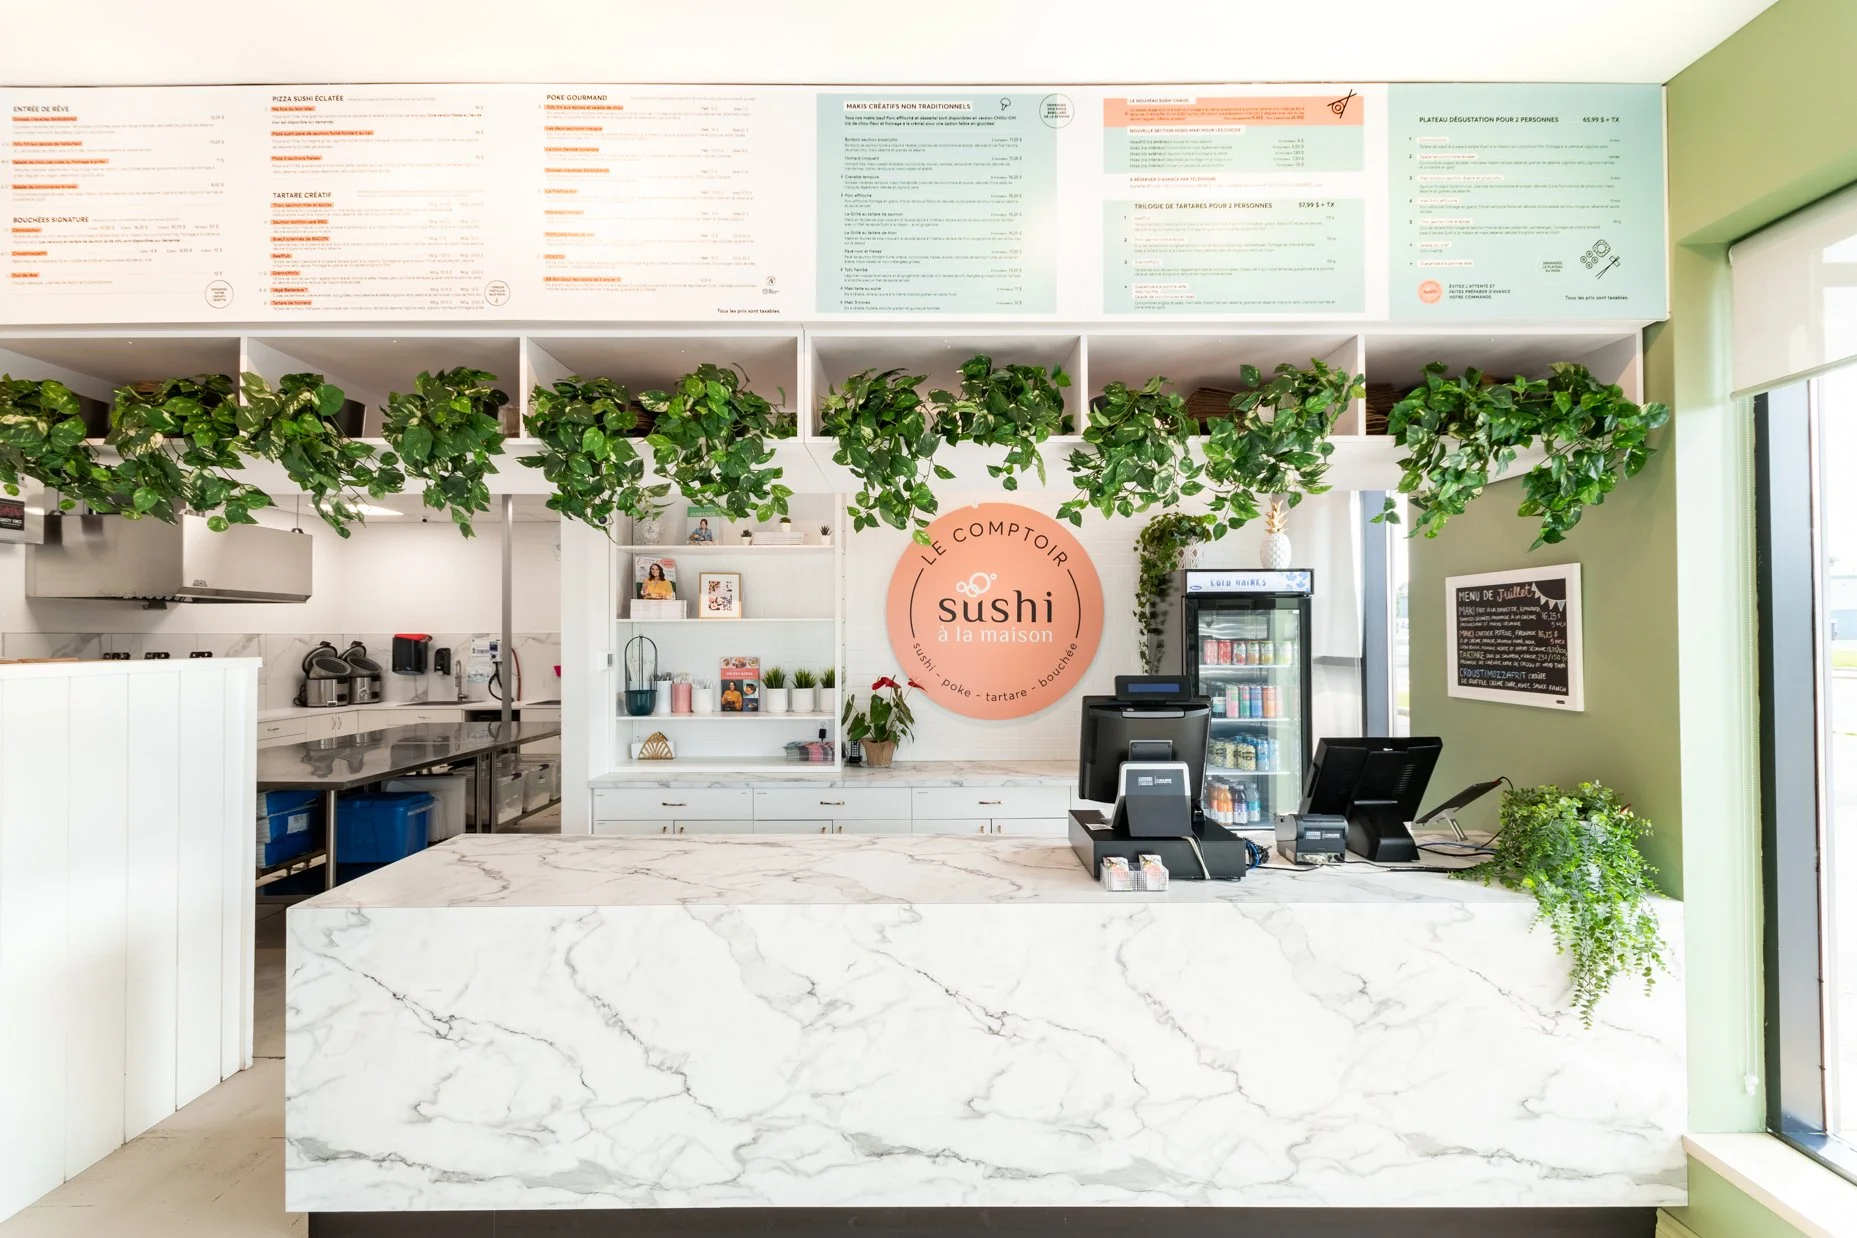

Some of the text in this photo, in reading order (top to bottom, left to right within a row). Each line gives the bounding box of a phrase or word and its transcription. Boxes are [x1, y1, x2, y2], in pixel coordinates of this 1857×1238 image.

[921, 521, 1068, 567] LE COMPTOIR
[1459, 586, 1533, 602] MENU DE Juillet
[939, 590, 1052, 622] sushi
[1459, 606, 1474, 615] MAKI
[937, 626, 1052, 642] à la maison
[914, 642, 1077, 701] sushi poke tartare bouchée
[1460, 668, 1526, 679] CROUSTIMOZZAFRIT
